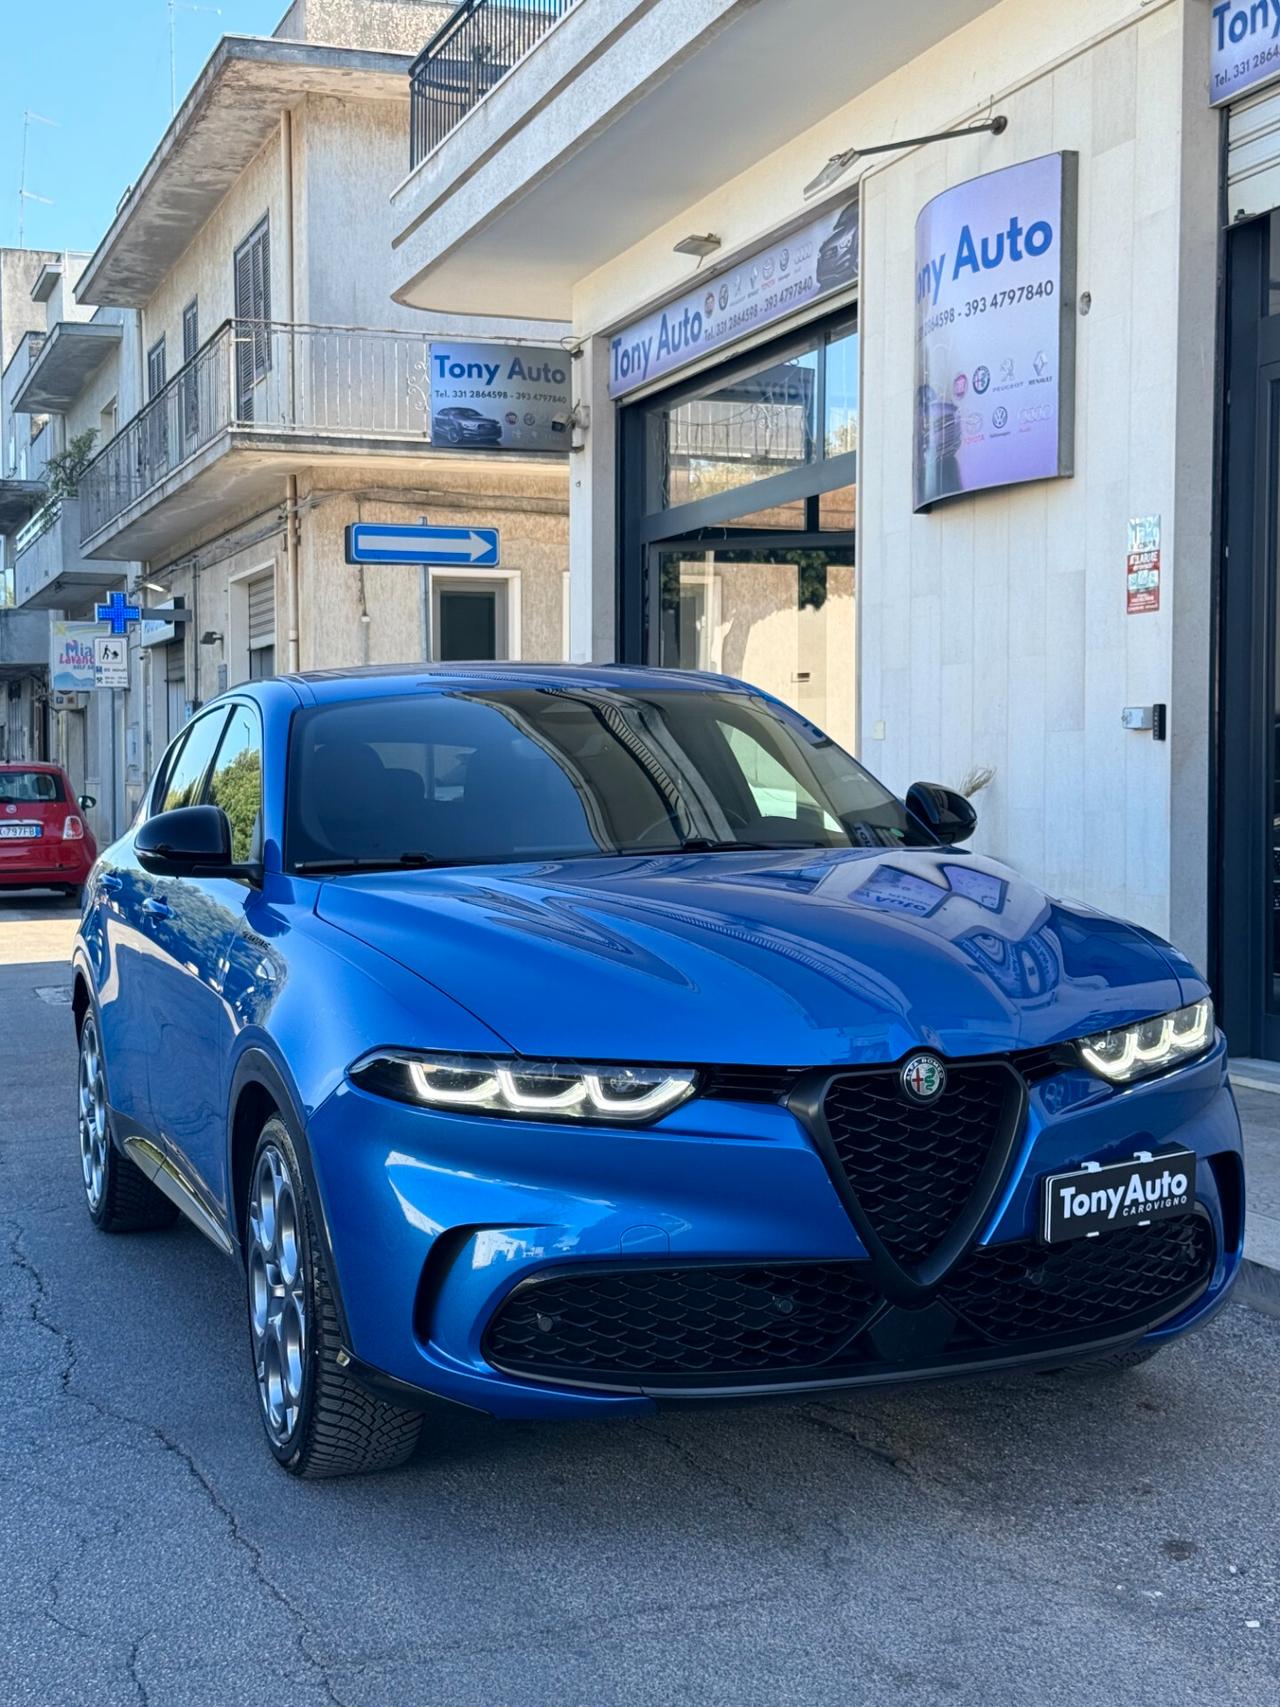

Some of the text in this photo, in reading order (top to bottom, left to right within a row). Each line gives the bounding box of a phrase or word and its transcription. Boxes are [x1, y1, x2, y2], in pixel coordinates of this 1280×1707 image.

[1214, 44, 1280, 87] Tel. 331 2864
[952, 216, 1053, 281] Auto
[964, 297, 987, 317] 393
[990, 279, 1054, 309] 4797840
[611, 307, 703, 381] Tony Auto
[434, 355, 566, 385] Tony Auto
[435, 390, 450, 399] Tel.
[452, 390, 467, 398] 331
[469, 390, 508, 399] 2864598
[65, 640, 92, 656] Mia
[1060, 1171, 1188, 1219] TonyAuto
[1122, 1195, 1188, 1216] CAROVIGNO
